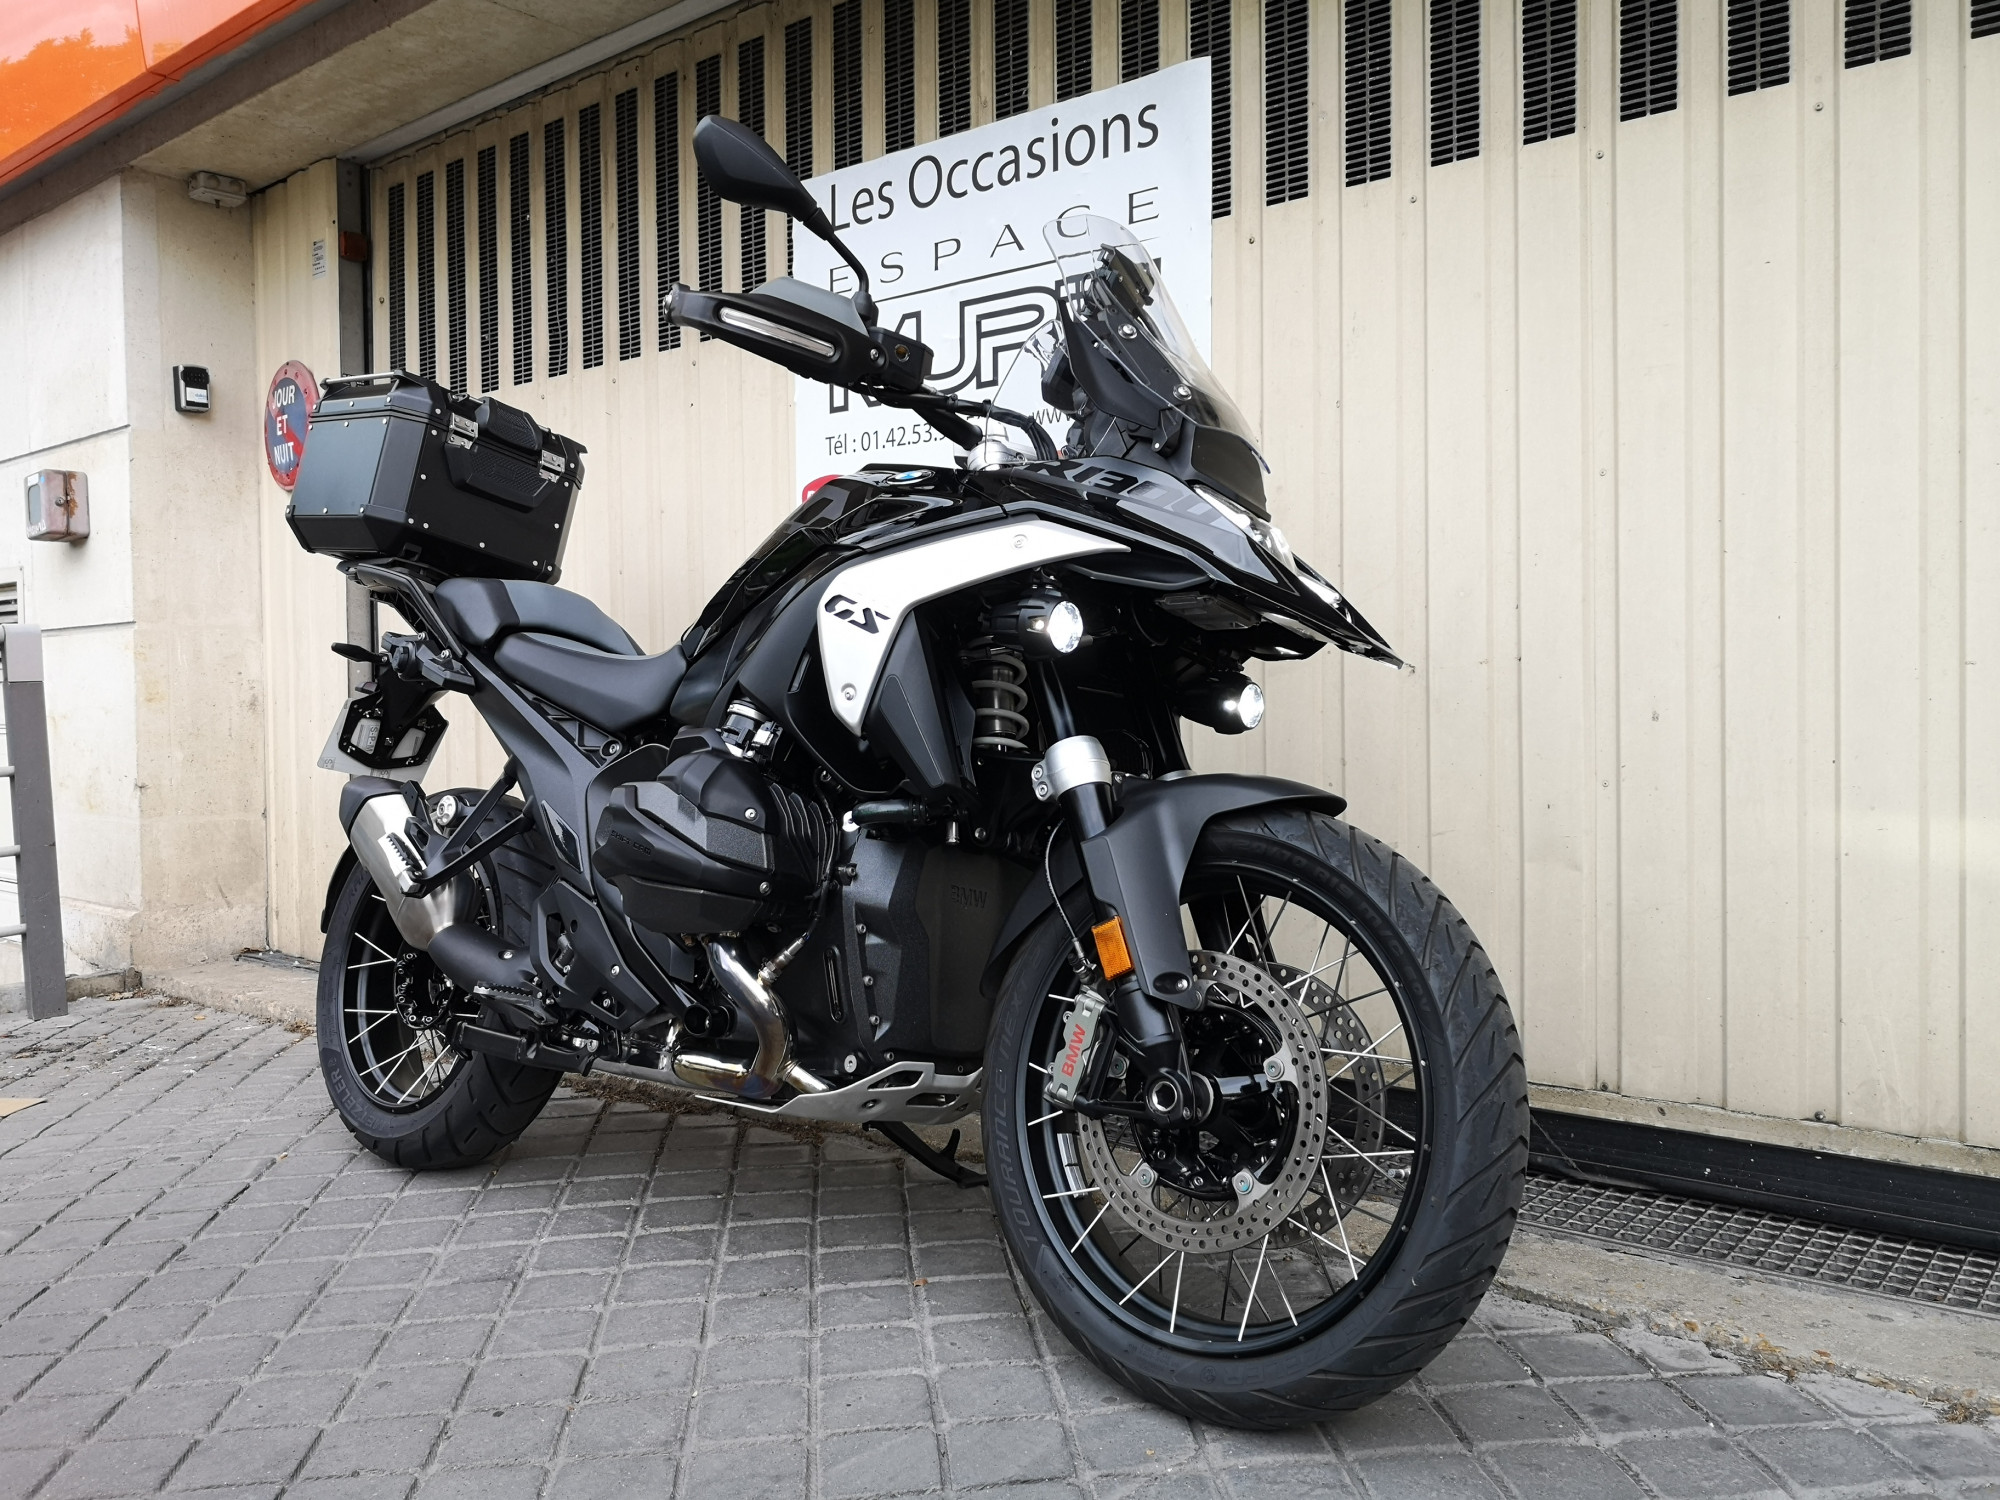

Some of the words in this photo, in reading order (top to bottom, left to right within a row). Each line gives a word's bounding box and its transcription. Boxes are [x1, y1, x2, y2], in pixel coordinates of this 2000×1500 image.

[830, 180, 895, 232] Les
[908, 103, 1160, 209] Occasions
[829, 186, 1160, 294] ESPACE
[272, 384, 296, 410] JOUR
[276, 414, 288, 436] ET
[825, 433, 848, 456] Tél
[860, 422, 947, 452] 01.42.53.
[273, 441, 295, 466] NUIT
[951, 884, 988, 909] BMW
[1061, 1023, 1086, 1078] BMW
